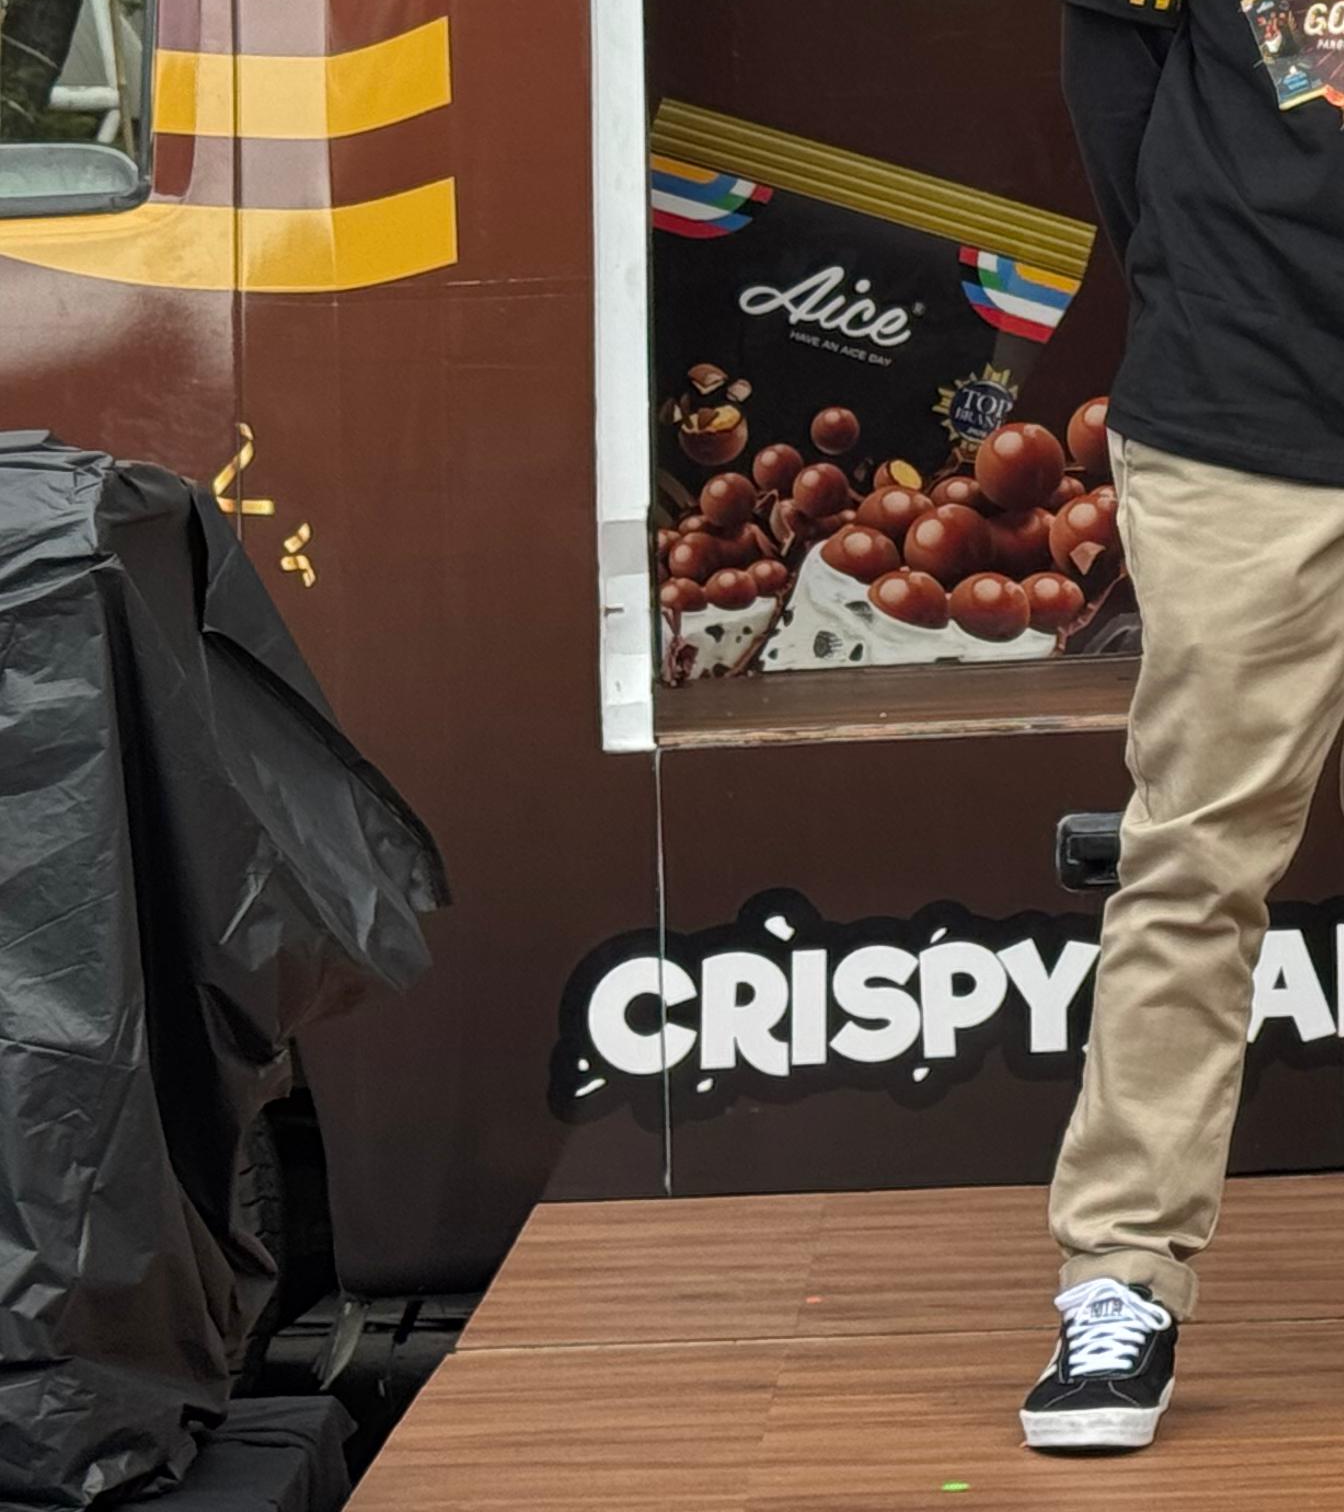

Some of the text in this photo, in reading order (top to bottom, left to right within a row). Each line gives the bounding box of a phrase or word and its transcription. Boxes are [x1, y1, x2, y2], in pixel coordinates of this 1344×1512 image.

[739, 266, 911, 346] Aice
[789, 329, 892, 367] HAVE AN AICE DAY
[962, 388, 1014, 418] TOP
[588, 938, 1101, 1077] CRISPY
